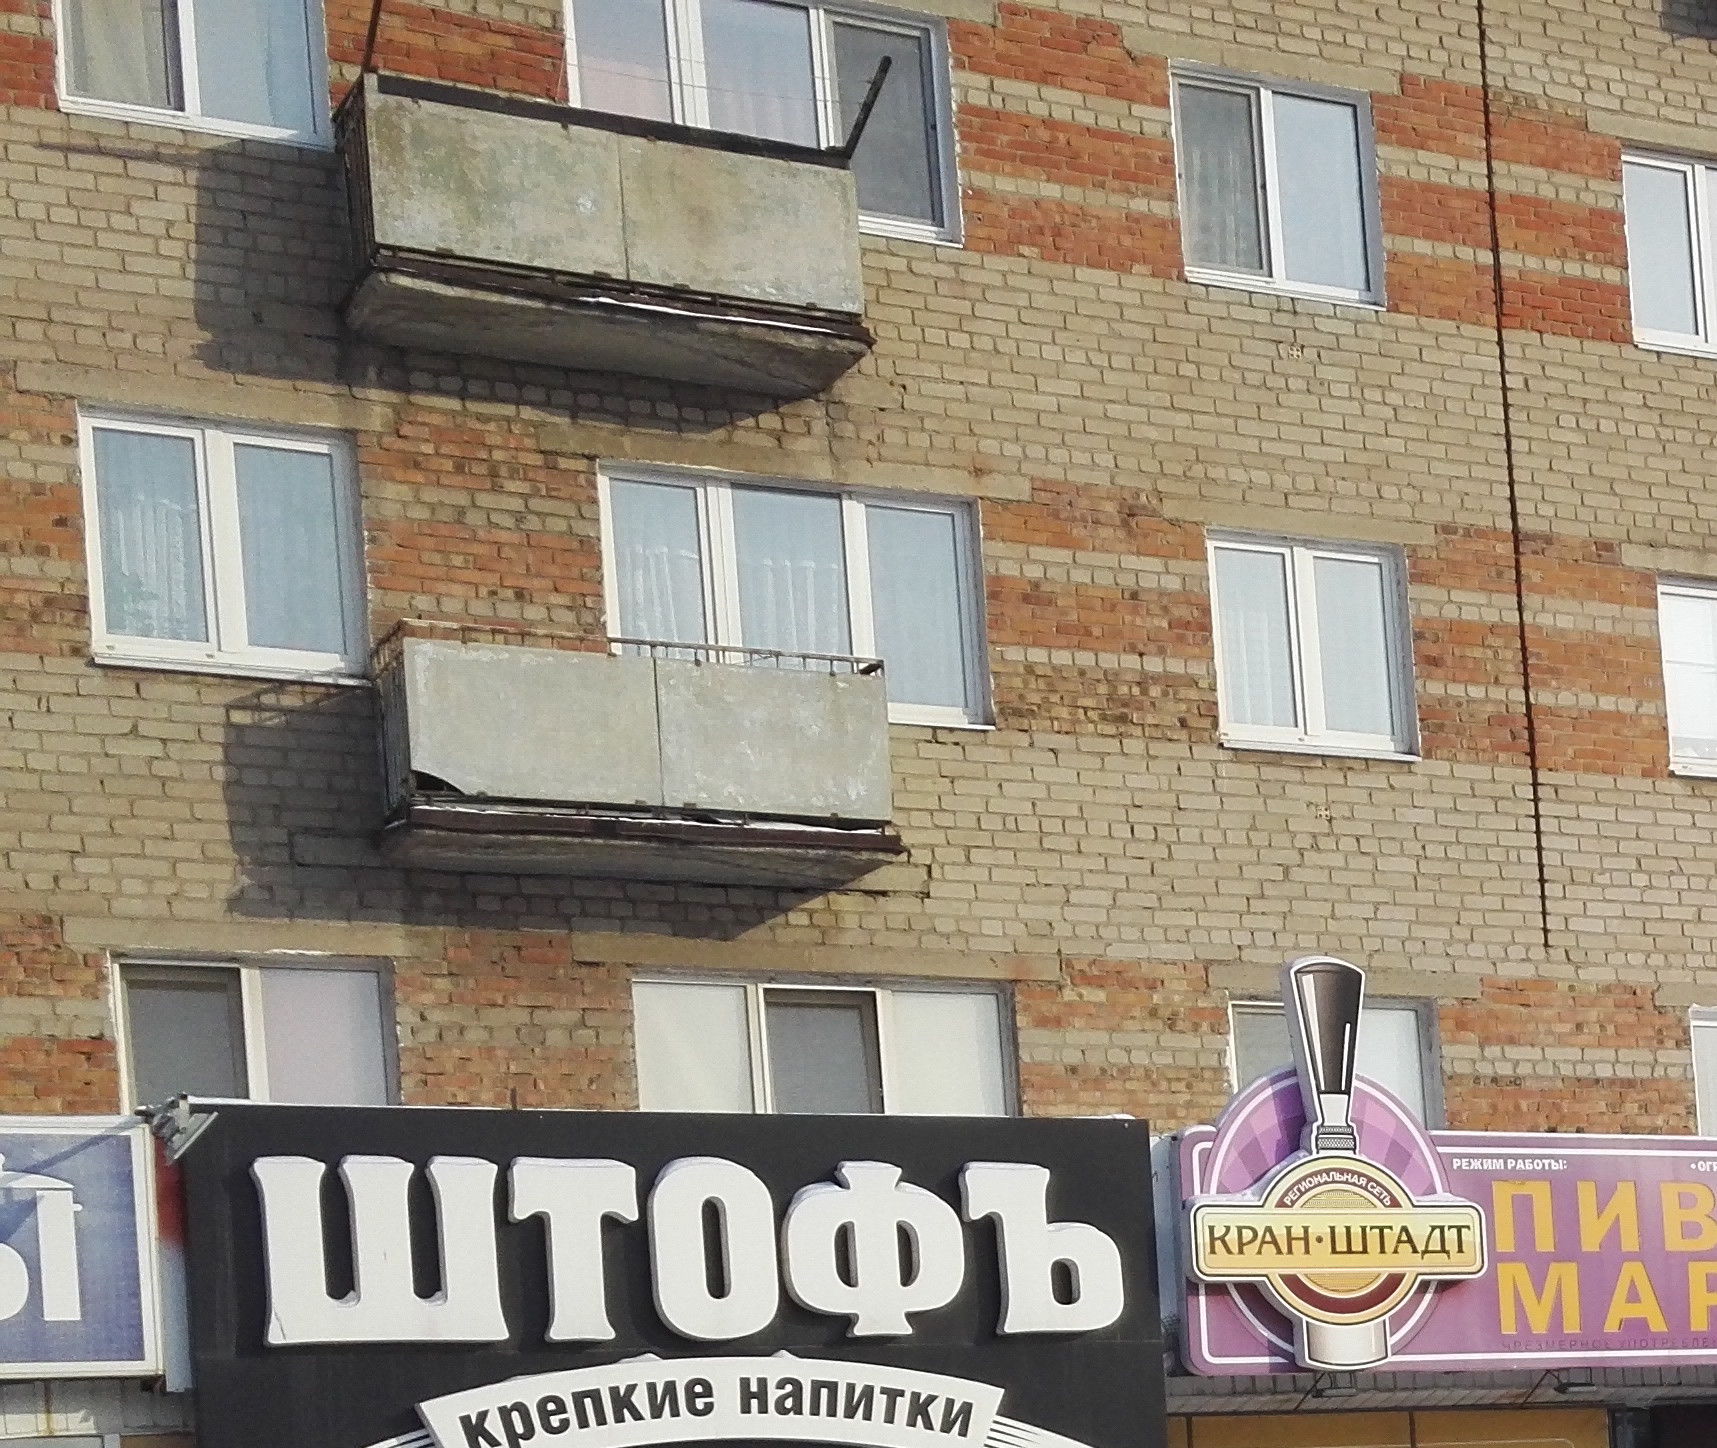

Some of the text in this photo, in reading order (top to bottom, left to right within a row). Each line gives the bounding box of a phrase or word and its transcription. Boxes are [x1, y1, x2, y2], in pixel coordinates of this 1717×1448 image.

[1283, 1171, 1392, 1207] РЕГИОНАЛЬНАЯ СЕТЬ
[1452, 1158, 1568, 1171] РЕЖИМ РАБОТЫ:
[248, 1154, 1126, 1347] ШТОФЪ
[738, 1374, 976, 1439] напитки
